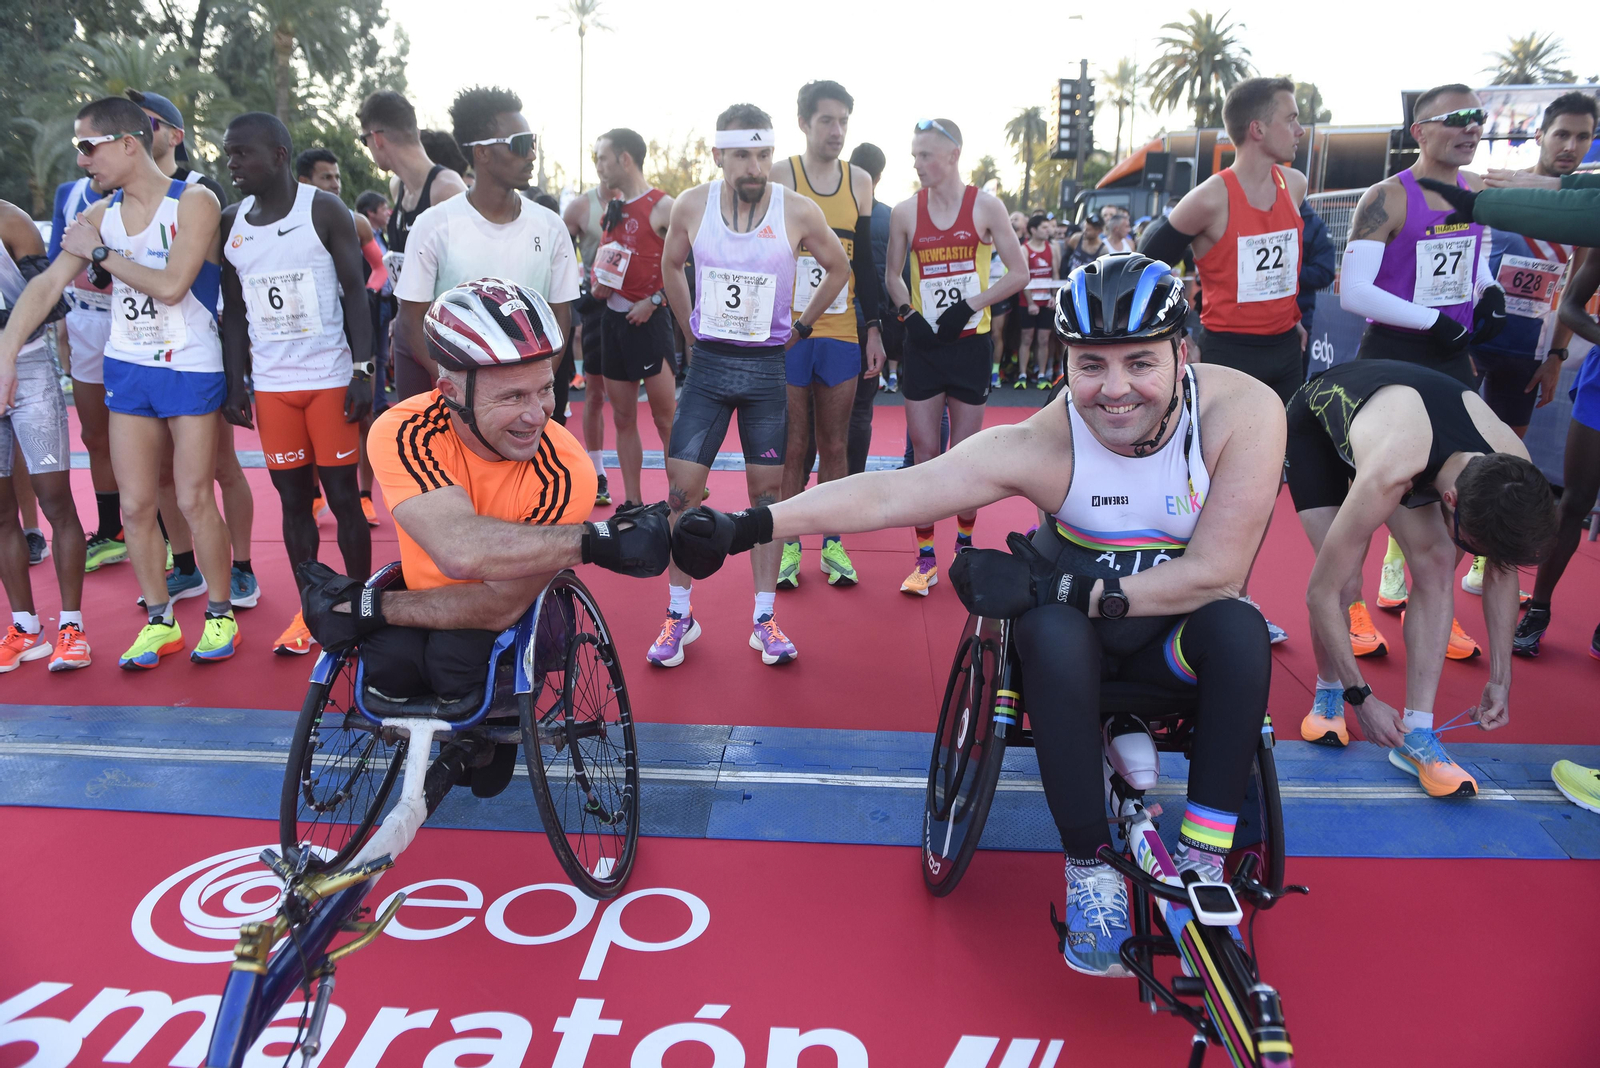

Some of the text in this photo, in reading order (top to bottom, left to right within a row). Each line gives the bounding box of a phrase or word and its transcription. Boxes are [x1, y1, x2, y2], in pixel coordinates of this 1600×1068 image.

[919, 246, 974, 263] NEWCASTLE
[1256, 246, 1283, 272] 22
[1433, 251, 1462, 277] 27
[1512, 271, 1543, 292] 628
[122, 297, 159, 321] 34
[268, 286, 284, 310] 6
[725, 284, 741, 309] 3
[934, 287, 962, 309] 29
[1311, 332, 1334, 370] edp
[1057, 573, 1073, 603] HARNESS
[362, 588, 373, 617] HARNESS
